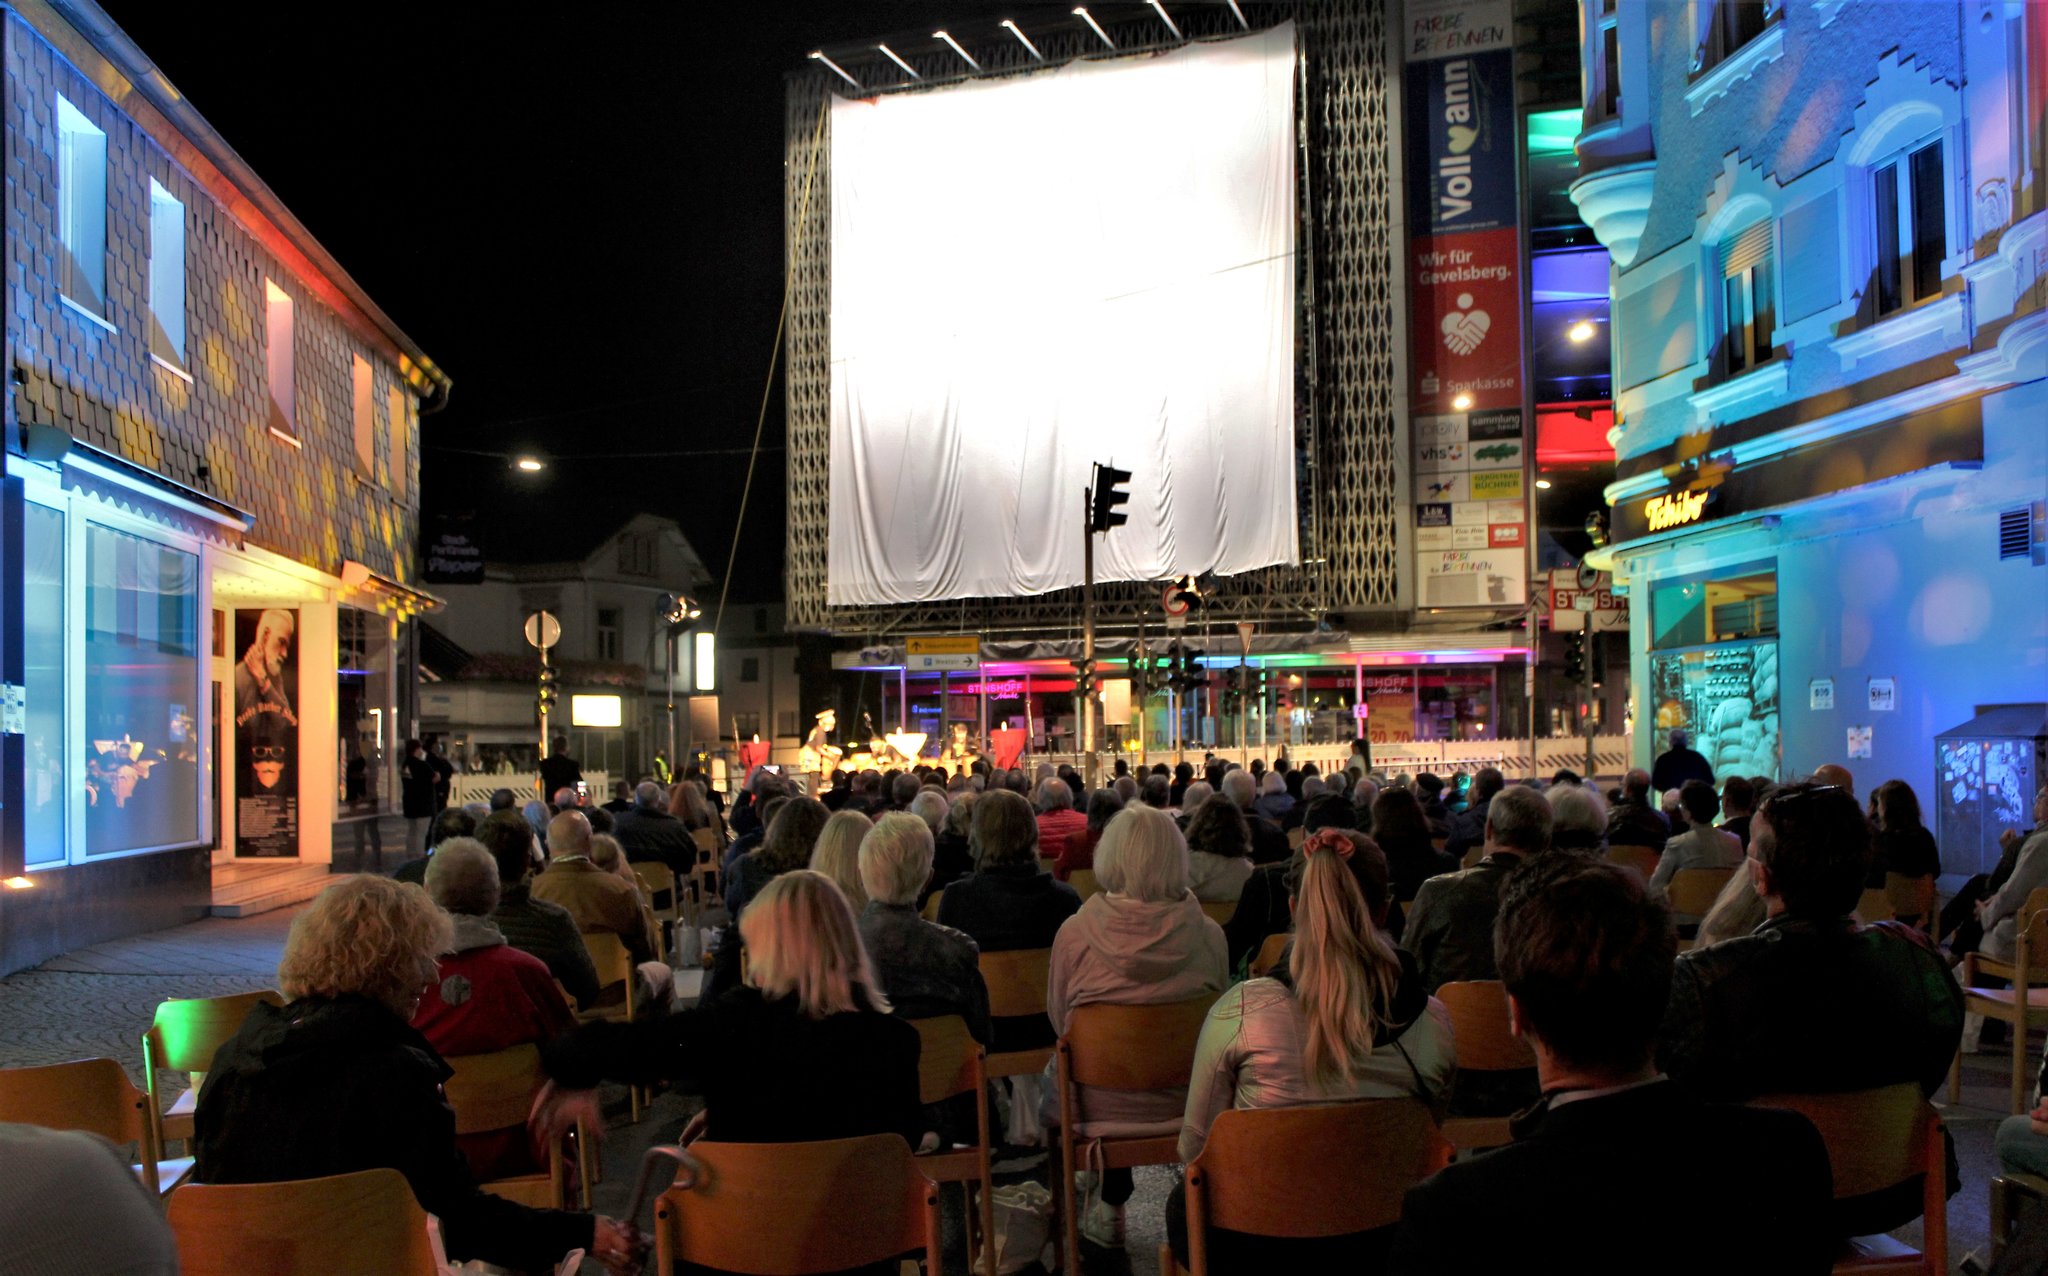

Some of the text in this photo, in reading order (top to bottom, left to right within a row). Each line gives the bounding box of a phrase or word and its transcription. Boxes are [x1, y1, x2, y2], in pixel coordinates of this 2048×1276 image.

[1418, 249, 1473, 267] Wir für
[1419, 265, 1512, 285] Gevelsberg.
[1446, 377, 1515, 394] Sparkasse
[1472, 414, 1520, 426] sammlung
[1421, 447, 1447, 460] vhs
[1645, 490, 1708, 531] Tchibo
